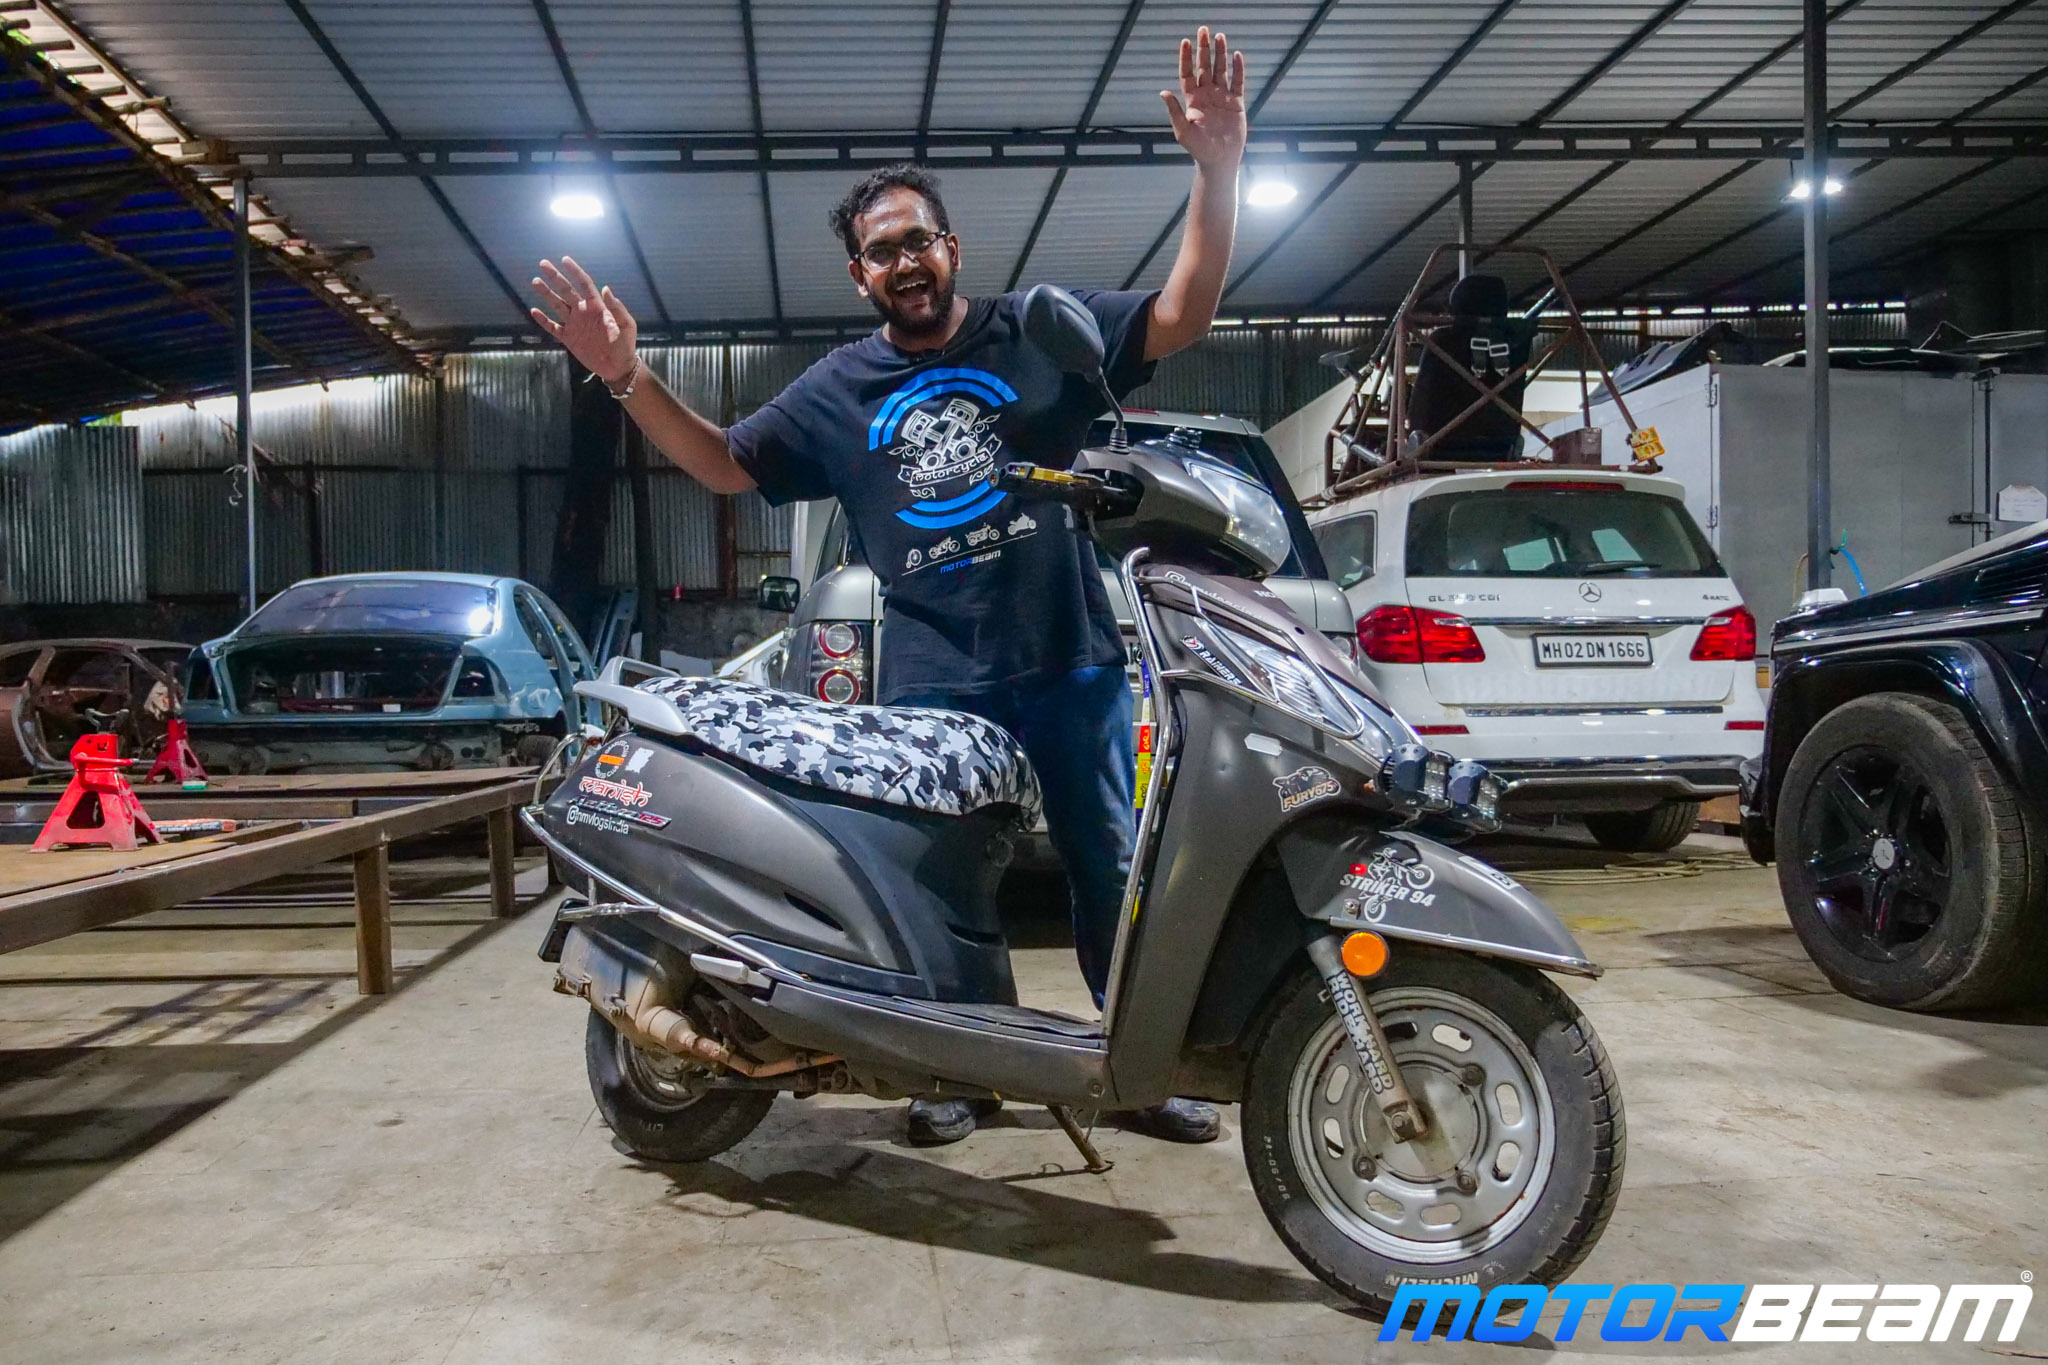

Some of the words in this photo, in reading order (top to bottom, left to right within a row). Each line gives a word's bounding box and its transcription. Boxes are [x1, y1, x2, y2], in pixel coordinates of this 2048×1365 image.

[1542, 641, 1645, 658] MH02DN1666
[1340, 873, 1410, 900] STRIKER
[1409, 890, 1436, 907] 94
